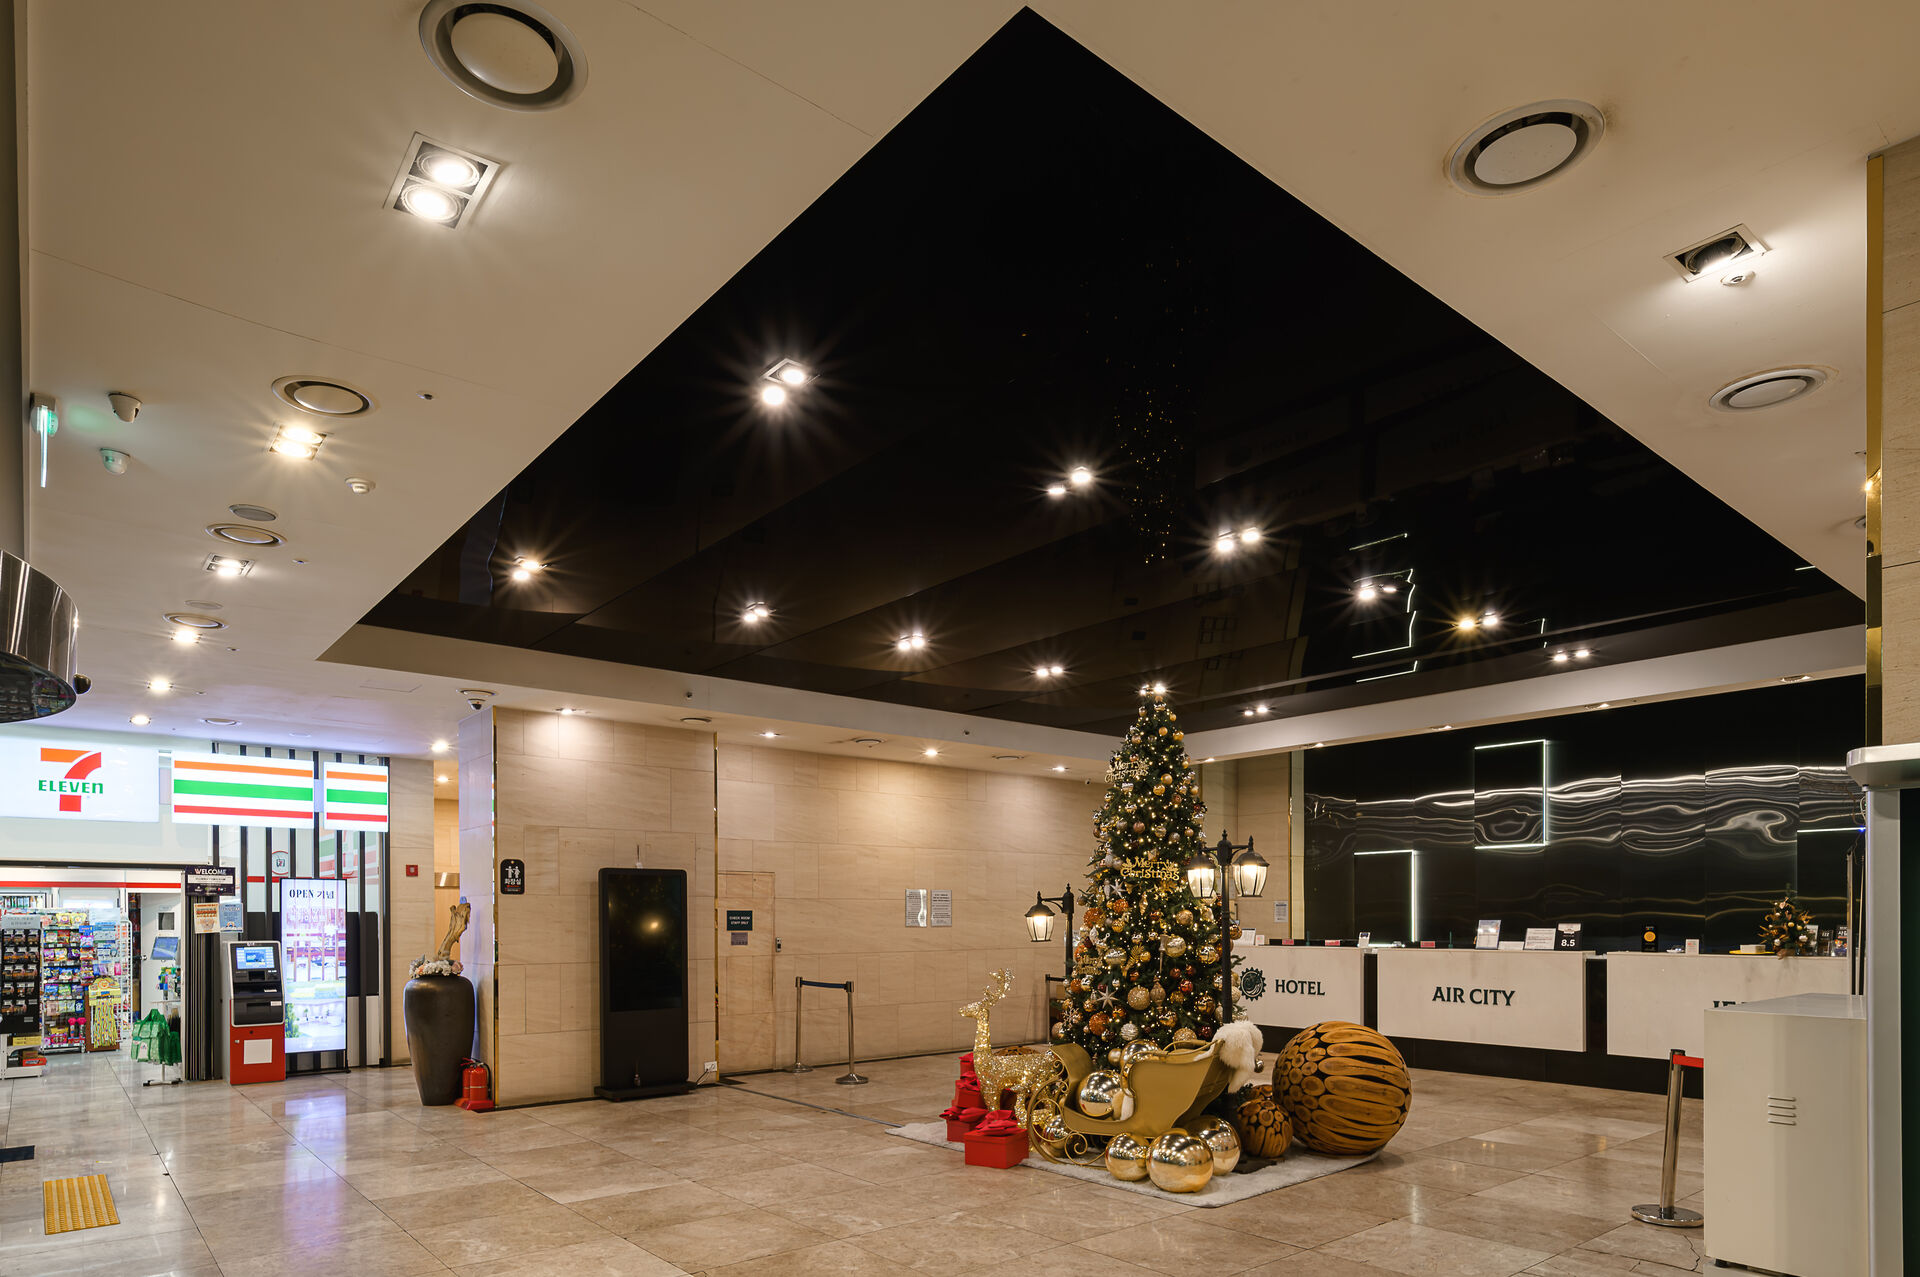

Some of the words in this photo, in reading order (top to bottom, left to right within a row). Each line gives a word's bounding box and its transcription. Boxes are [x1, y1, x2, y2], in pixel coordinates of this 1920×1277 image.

[1114, 760, 1140, 770] Merry
[40, 748, 102, 812] 7
[1105, 769, 1148, 782] Christmas
[1133, 856, 1169, 869] Merry
[1120, 867, 1180, 880] Christmas
[289, 889, 314, 898] OPEN
[1561, 939, 1576, 947] 8.5
[1275, 979, 1325, 995] HOTEL
[1432, 986, 1465, 1003] AIR
[1469, 988, 1516, 1006] CITY
